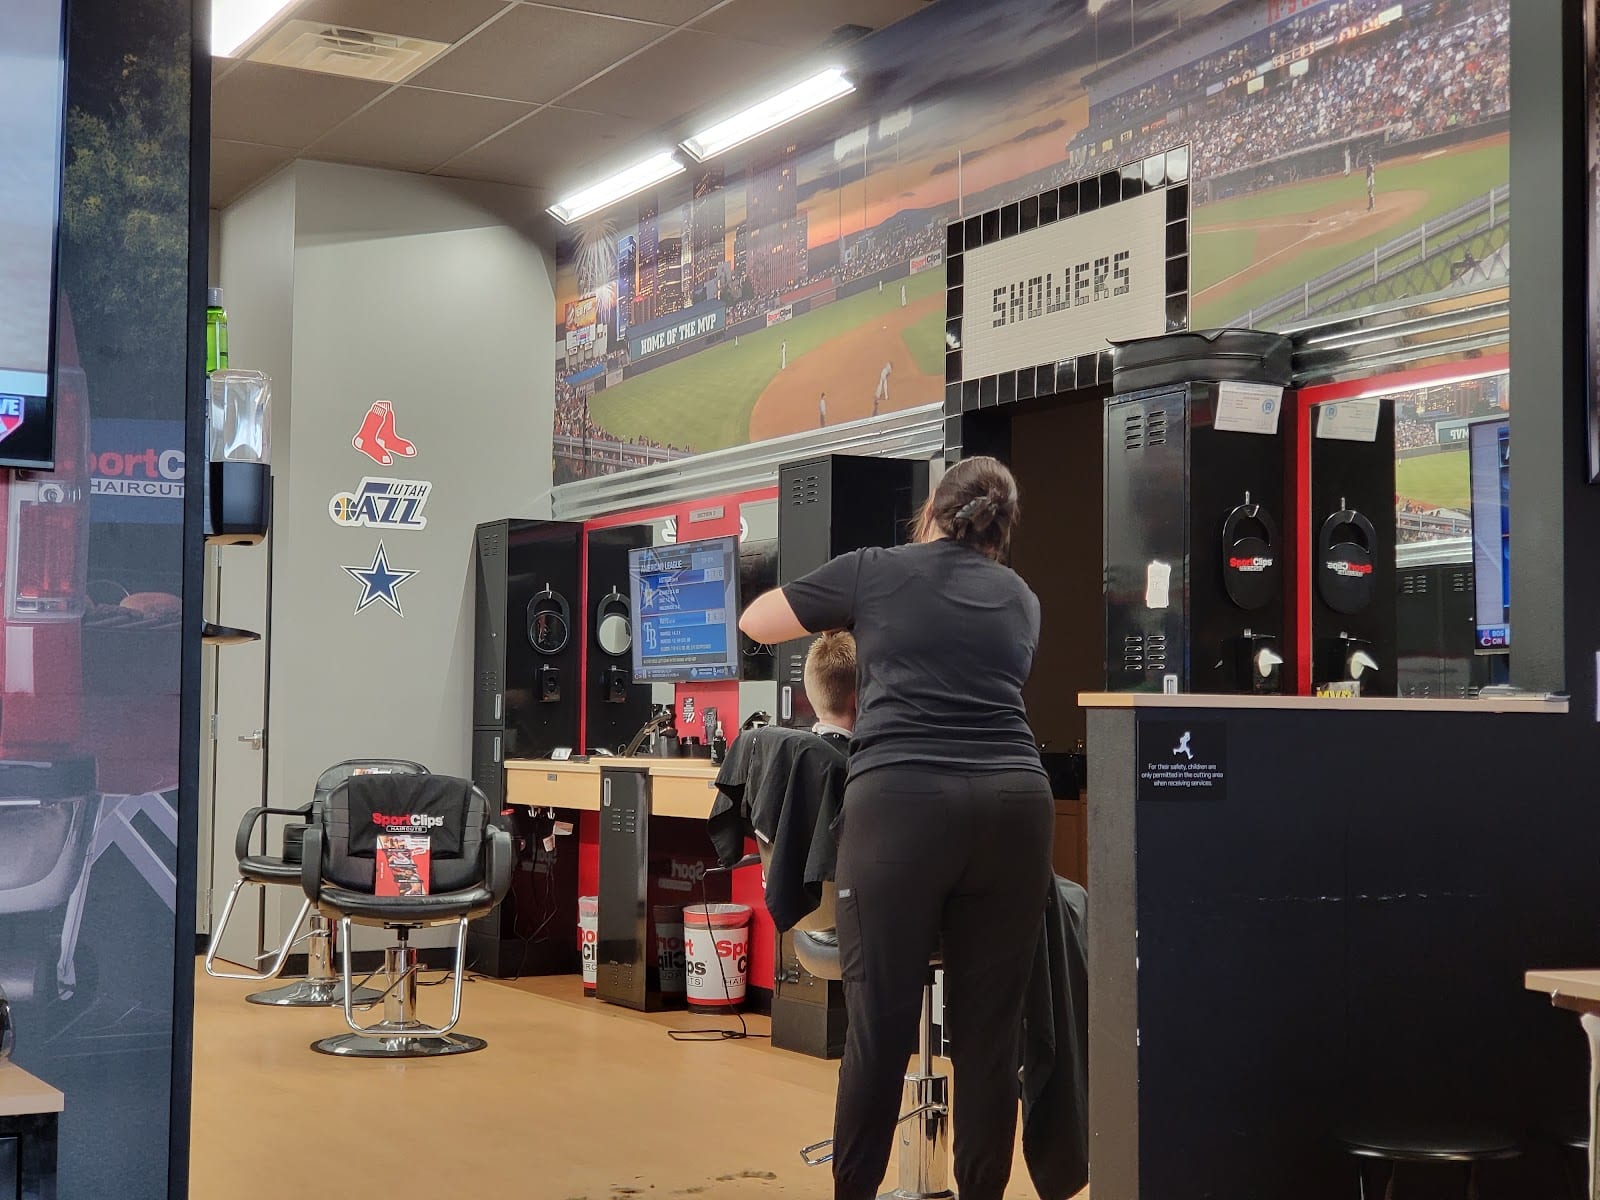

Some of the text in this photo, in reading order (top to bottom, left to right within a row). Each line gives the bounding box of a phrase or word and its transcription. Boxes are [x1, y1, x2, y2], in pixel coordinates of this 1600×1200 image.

[993, 250, 1129, 328] SHOWERS
[640, 313, 717, 355] HOME OF THE MVP
[393, 484, 428, 498] UTAH
[664, 560, 682, 570] LEAGUE
[1170, 763, 1187, 771] safety,
[1193, 772, 1212, 780] cutting
[1168, 780, 1190, 788] receiving
[372, 812, 444, 829] SportClips
